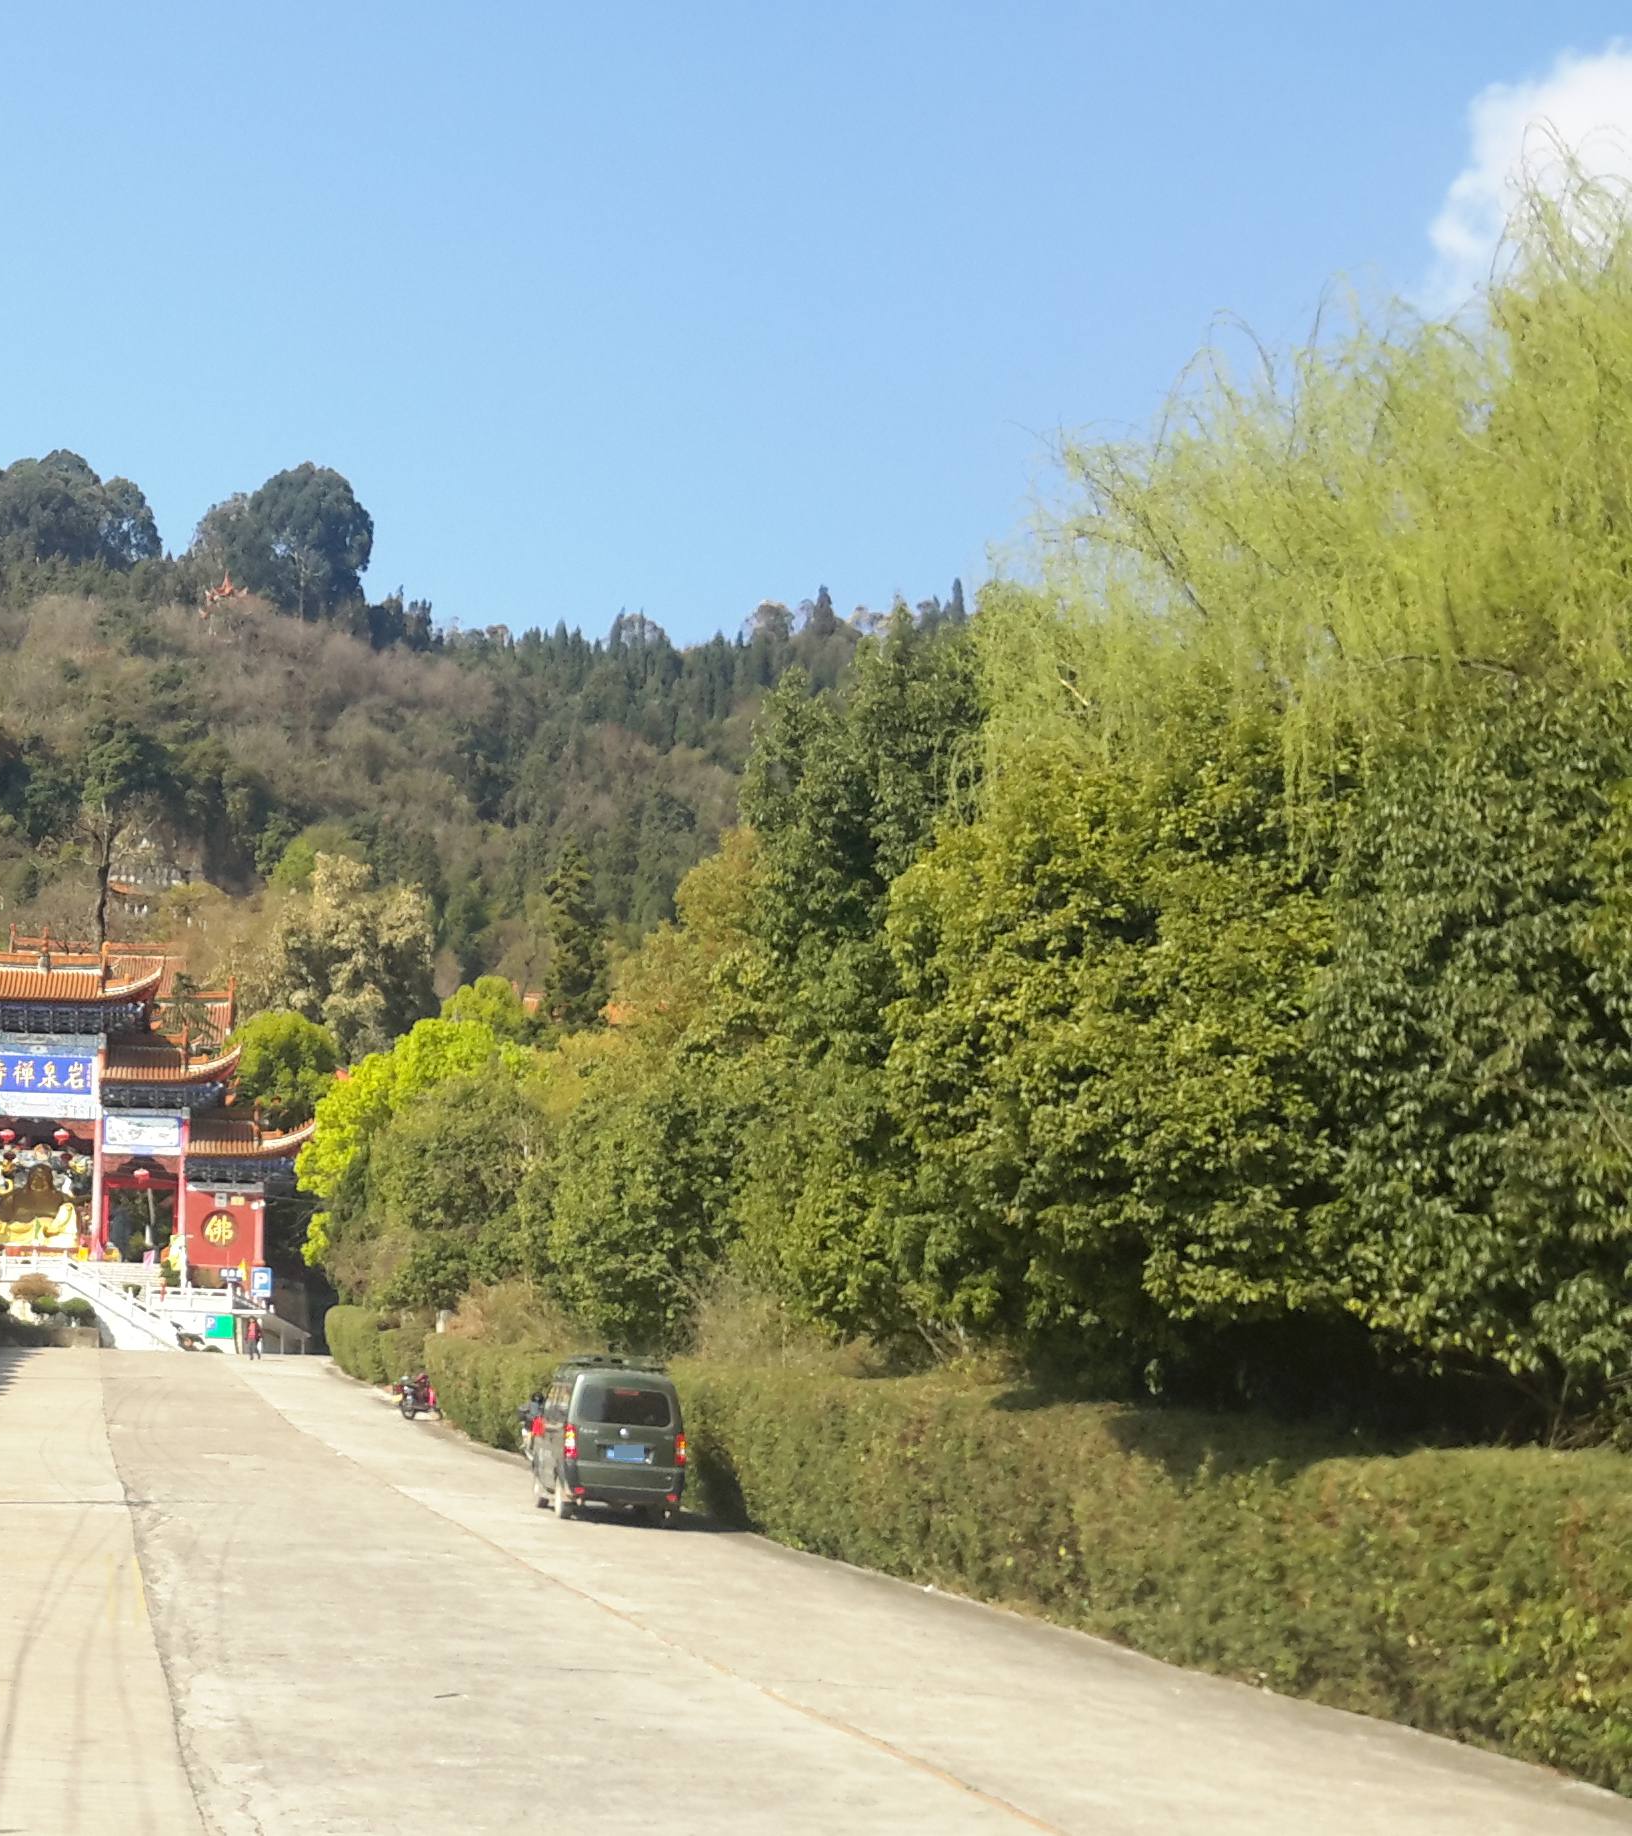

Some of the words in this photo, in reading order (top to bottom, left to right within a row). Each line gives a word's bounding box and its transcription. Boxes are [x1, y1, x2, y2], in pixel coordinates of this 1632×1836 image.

[205, 1215, 234, 1245] 佛
[254, 1272, 269, 1290] P
[206, 1317, 216, 1328] P
